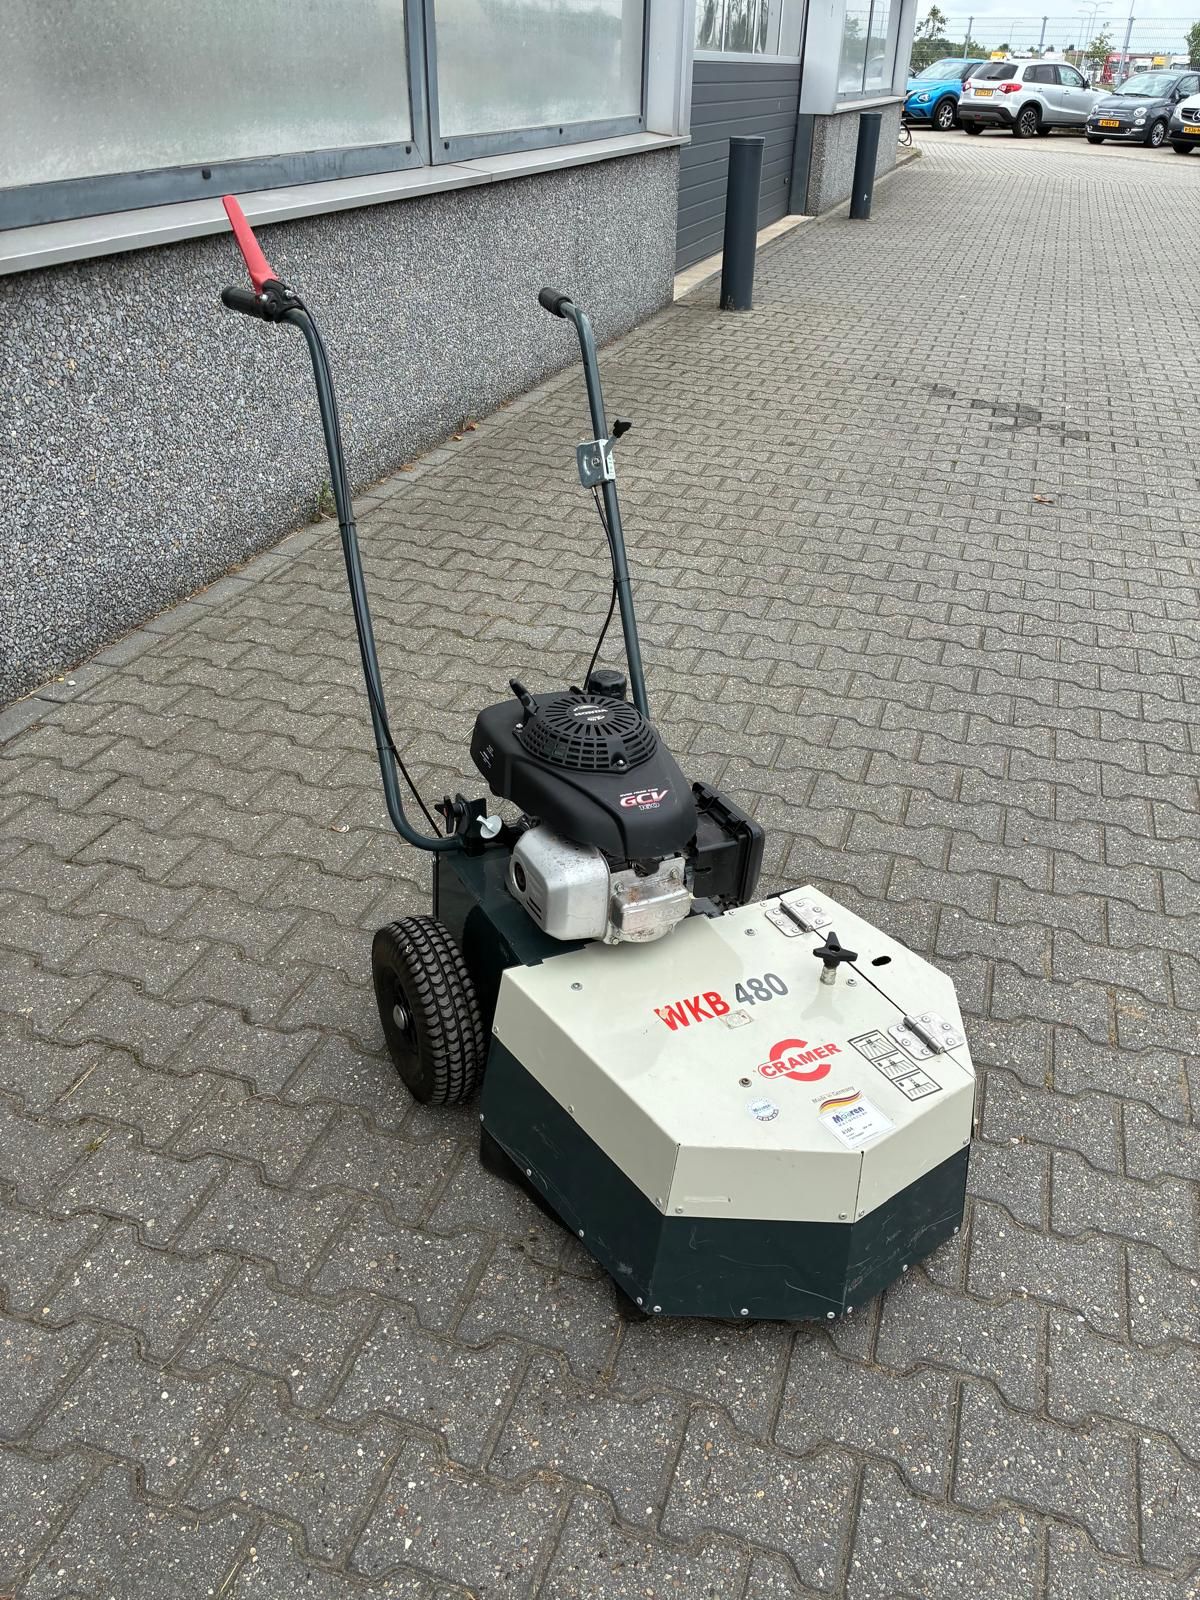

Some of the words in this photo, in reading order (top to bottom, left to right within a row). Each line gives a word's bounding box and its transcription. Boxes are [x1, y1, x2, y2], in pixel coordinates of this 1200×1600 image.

[620, 790, 669, 807] GCV
[653, 991, 731, 1031] WKB
[734, 973, 789, 1006] 480
[760, 1043, 843, 1078] CRAMER
